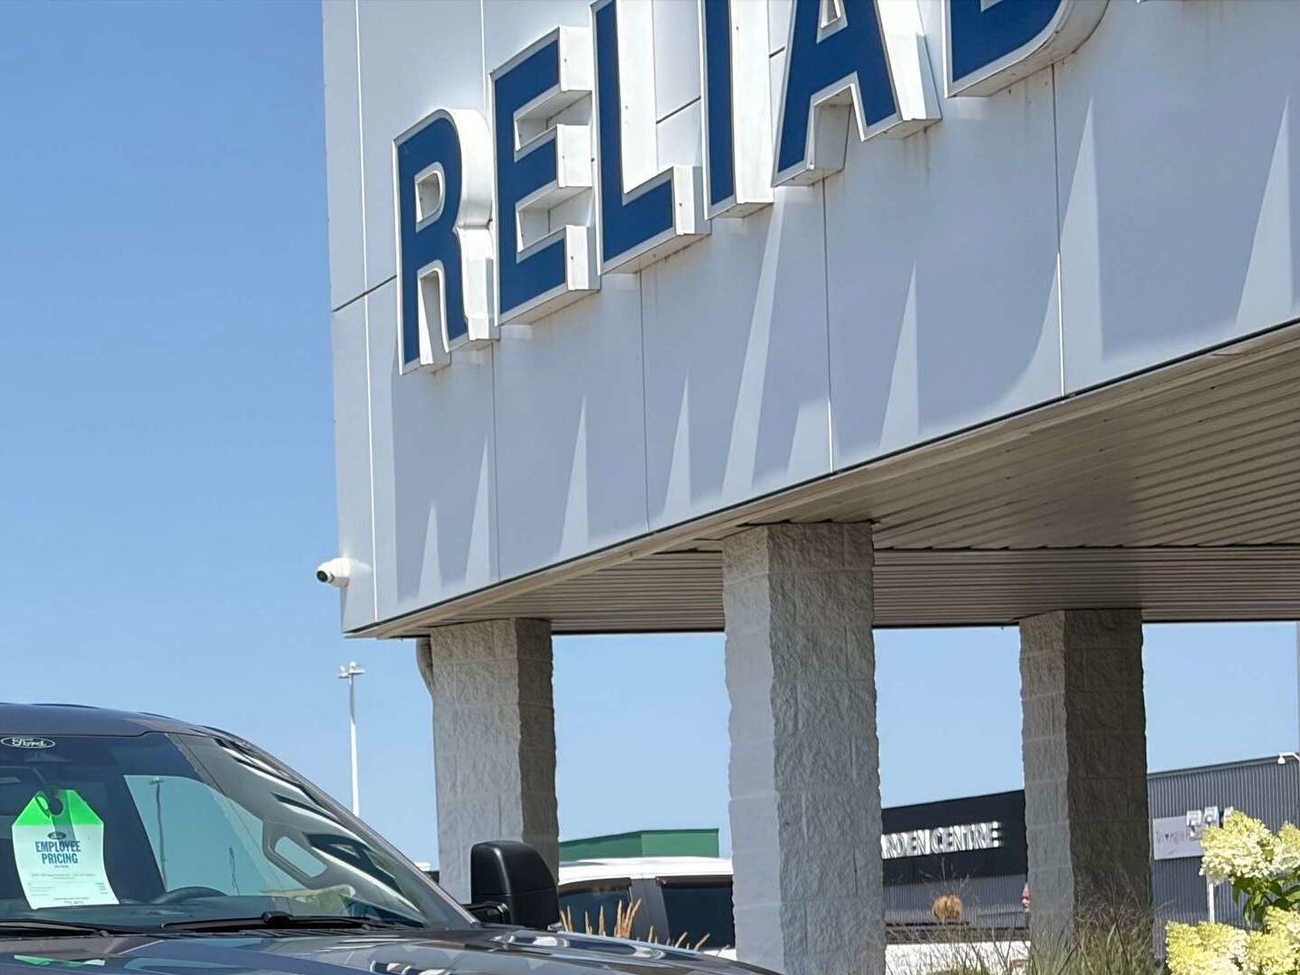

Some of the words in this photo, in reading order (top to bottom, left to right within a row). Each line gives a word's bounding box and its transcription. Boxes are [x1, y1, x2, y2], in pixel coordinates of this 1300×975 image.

[931, 821, 1000, 854] CENTRE
[35, 841, 81, 852] EMPLOYEE
[41, 853, 78, 864] PRICING
